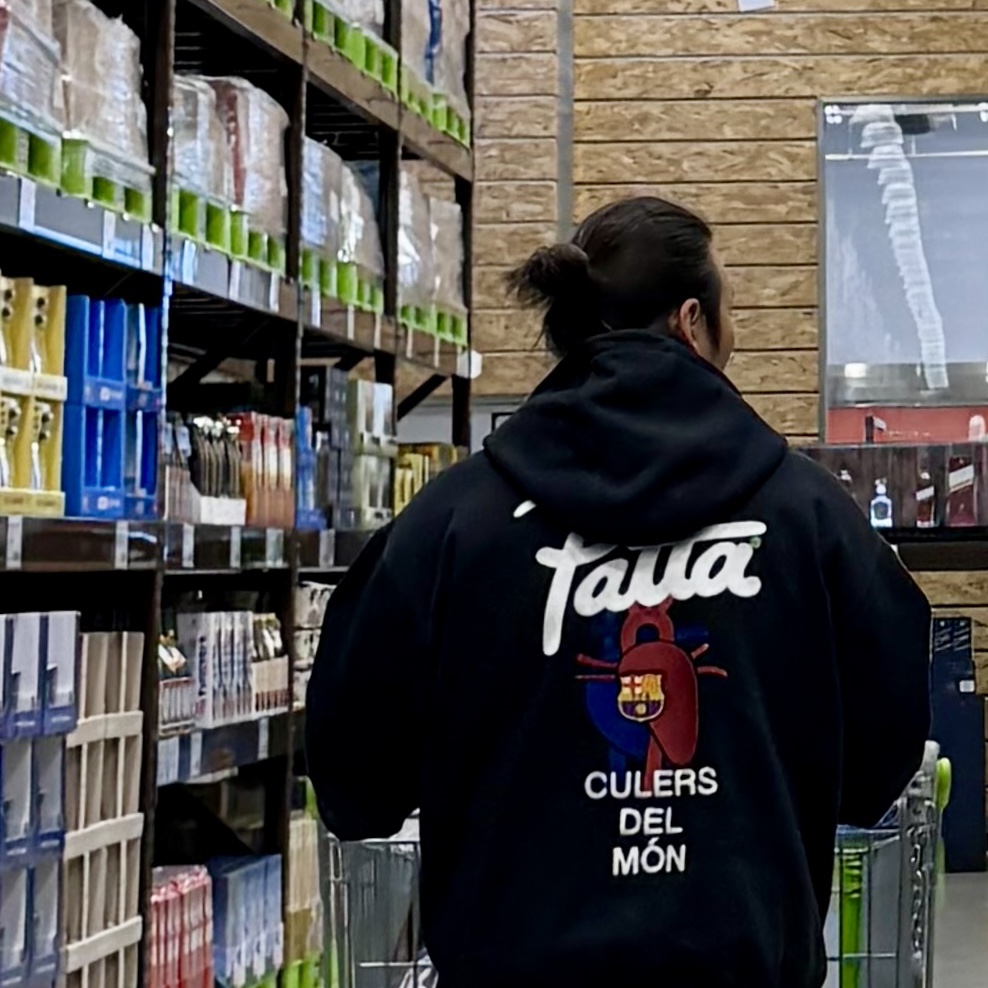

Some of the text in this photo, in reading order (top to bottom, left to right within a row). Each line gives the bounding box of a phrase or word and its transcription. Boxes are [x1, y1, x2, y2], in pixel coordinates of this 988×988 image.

[584, 766, 718, 799] CULERS
[619, 807, 683, 836] DEL
[612, 838, 687, 876] MÓN
